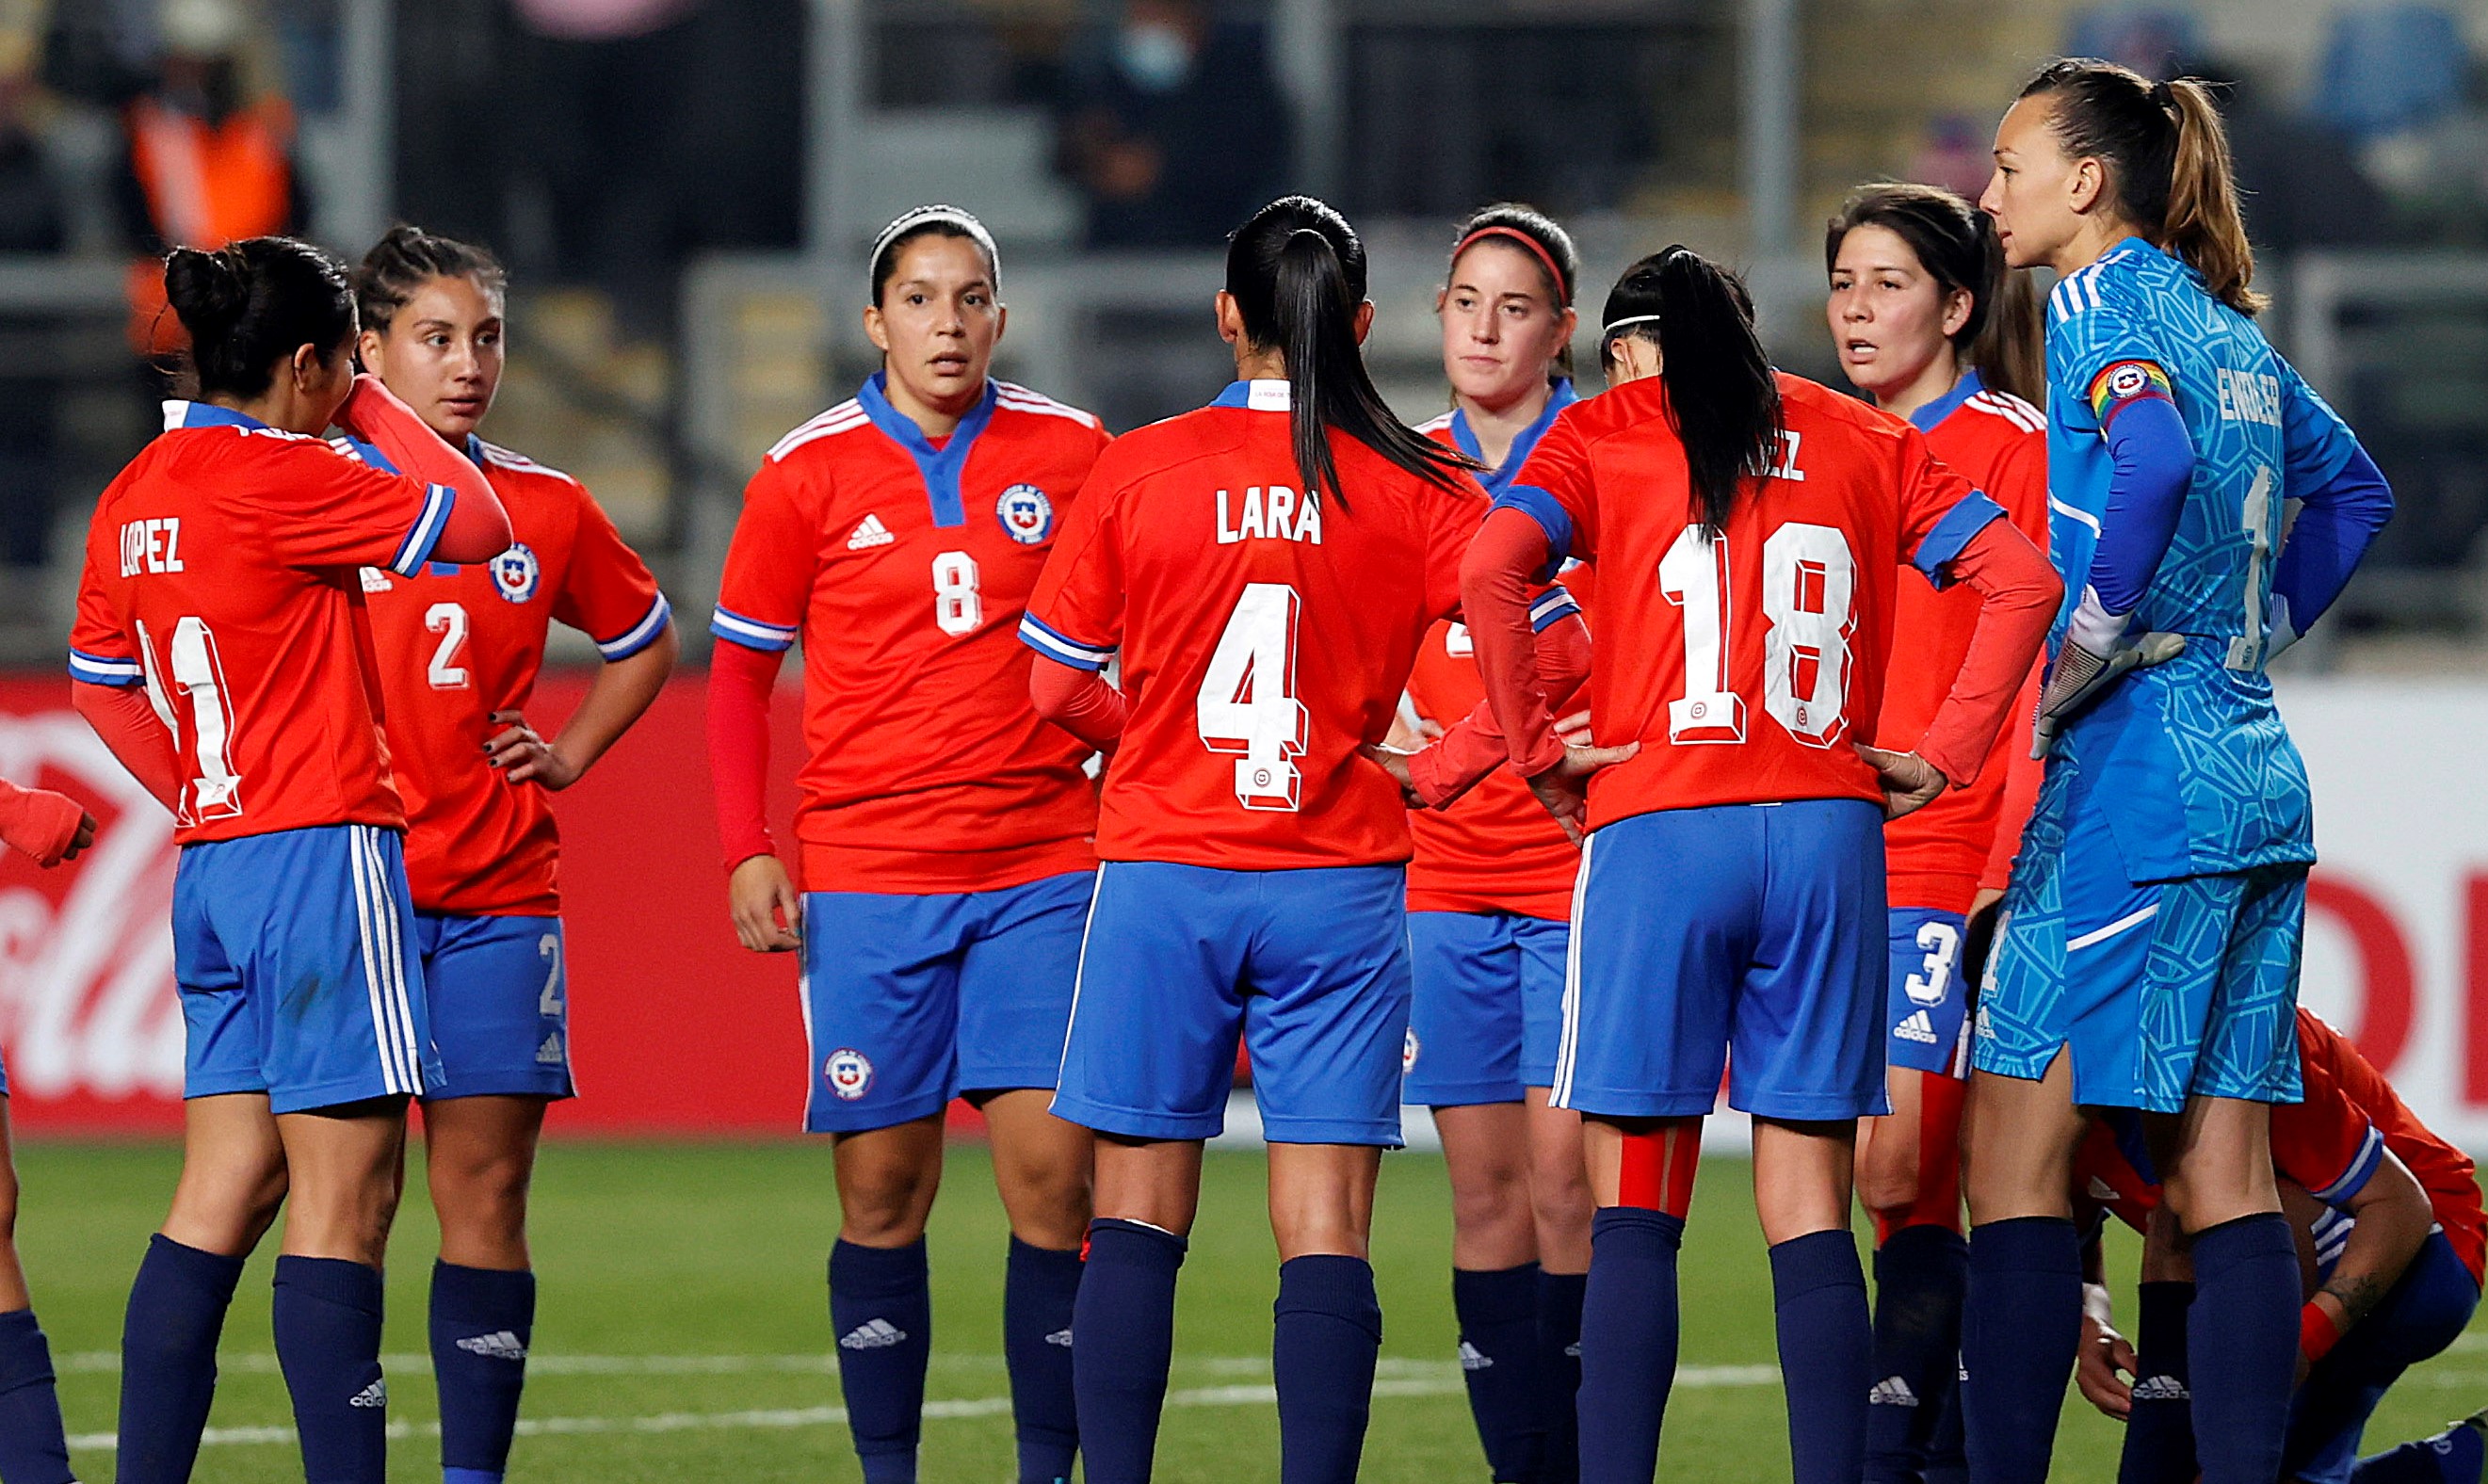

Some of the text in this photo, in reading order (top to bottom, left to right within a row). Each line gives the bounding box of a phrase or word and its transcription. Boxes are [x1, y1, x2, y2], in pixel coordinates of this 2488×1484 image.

[120, 517, 185, 578] LOPEZ
[1216, 485, 1322, 544] LARA
[932, 550, 983, 637] 8
[2223, 465, 2270, 672] 1
[426, 602, 469, 690] 2
[1658, 522, 1857, 750] 18
[1197, 583, 1307, 812] 4
[539, 933, 563, 1016] 2
[1904, 921, 1959, 1008] 3
[1893, 1026, 1937, 1044] adidas
[2132, 1388, 2189, 1399] adidas
